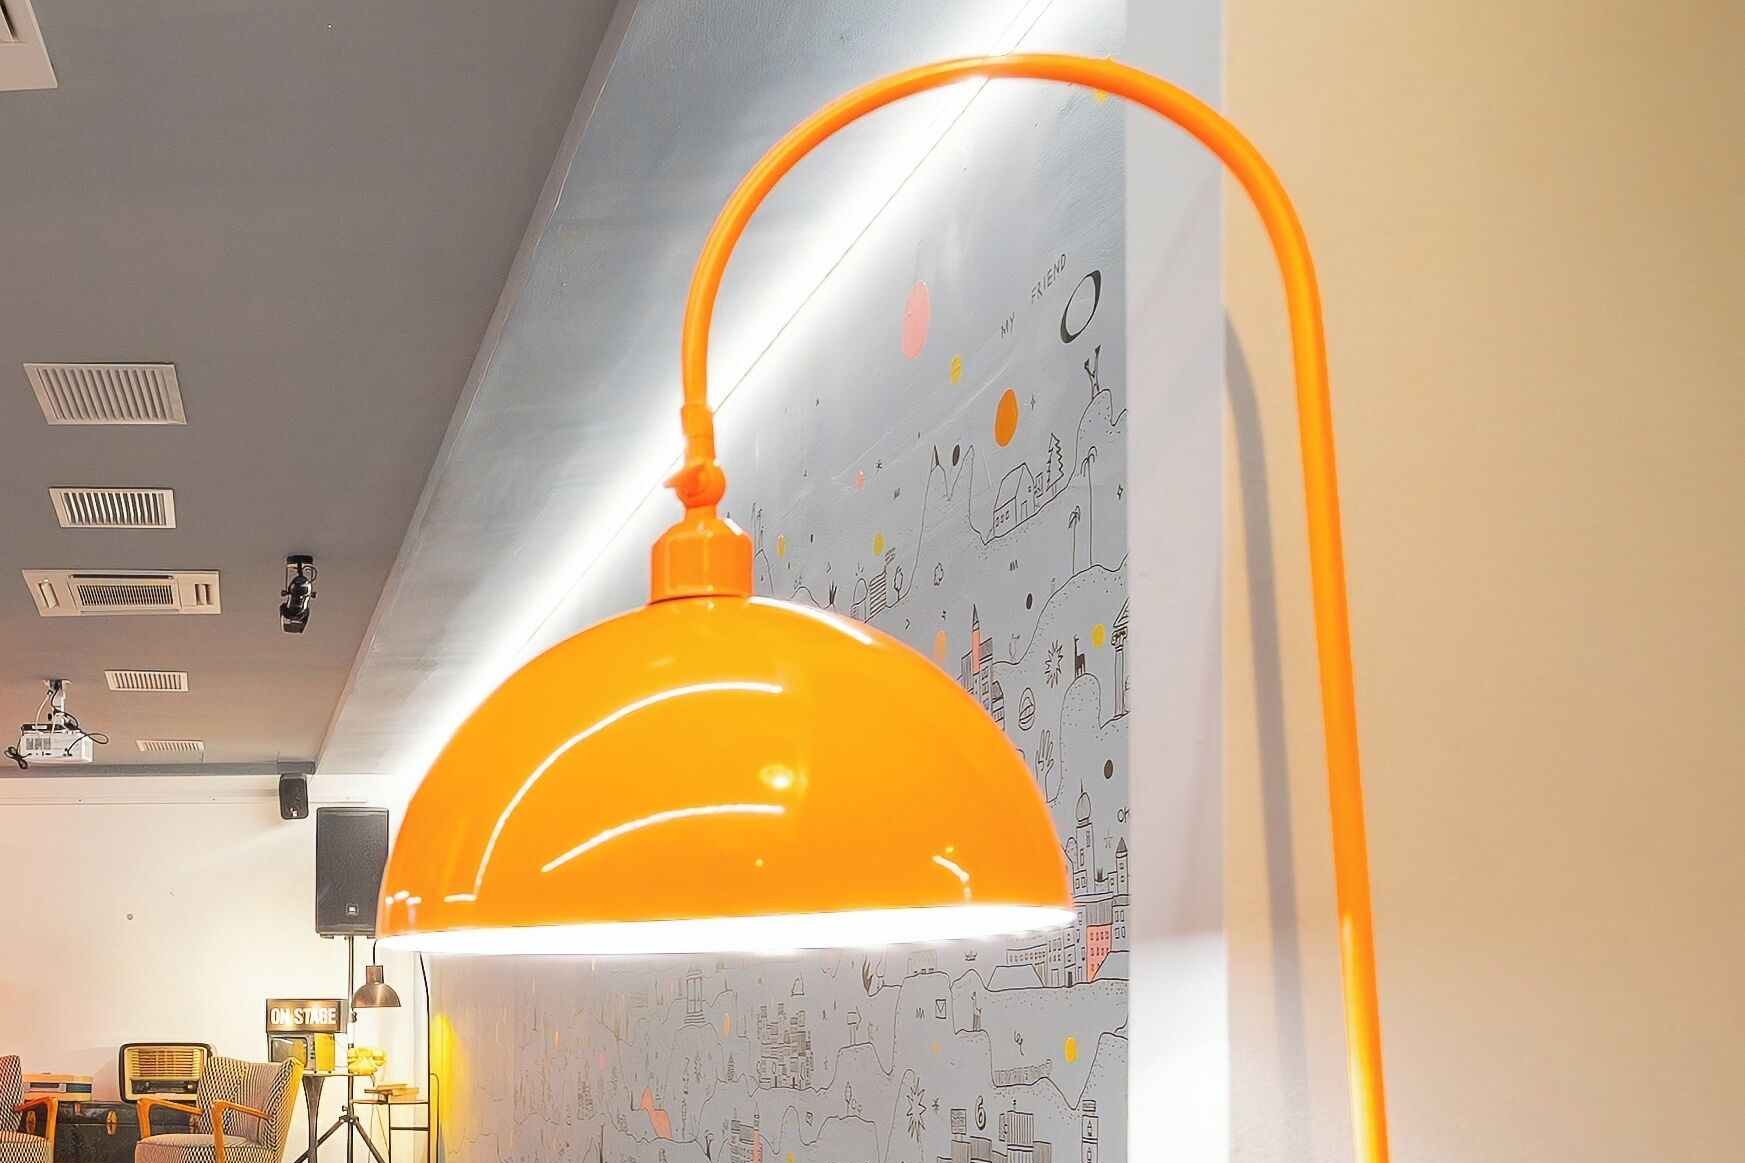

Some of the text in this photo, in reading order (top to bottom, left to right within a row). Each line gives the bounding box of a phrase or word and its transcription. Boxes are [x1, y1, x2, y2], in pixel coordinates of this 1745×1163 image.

[1000, 253, 1067, 338] MY FRIEND
[270, 1006, 337, 1025] ON STAGE
